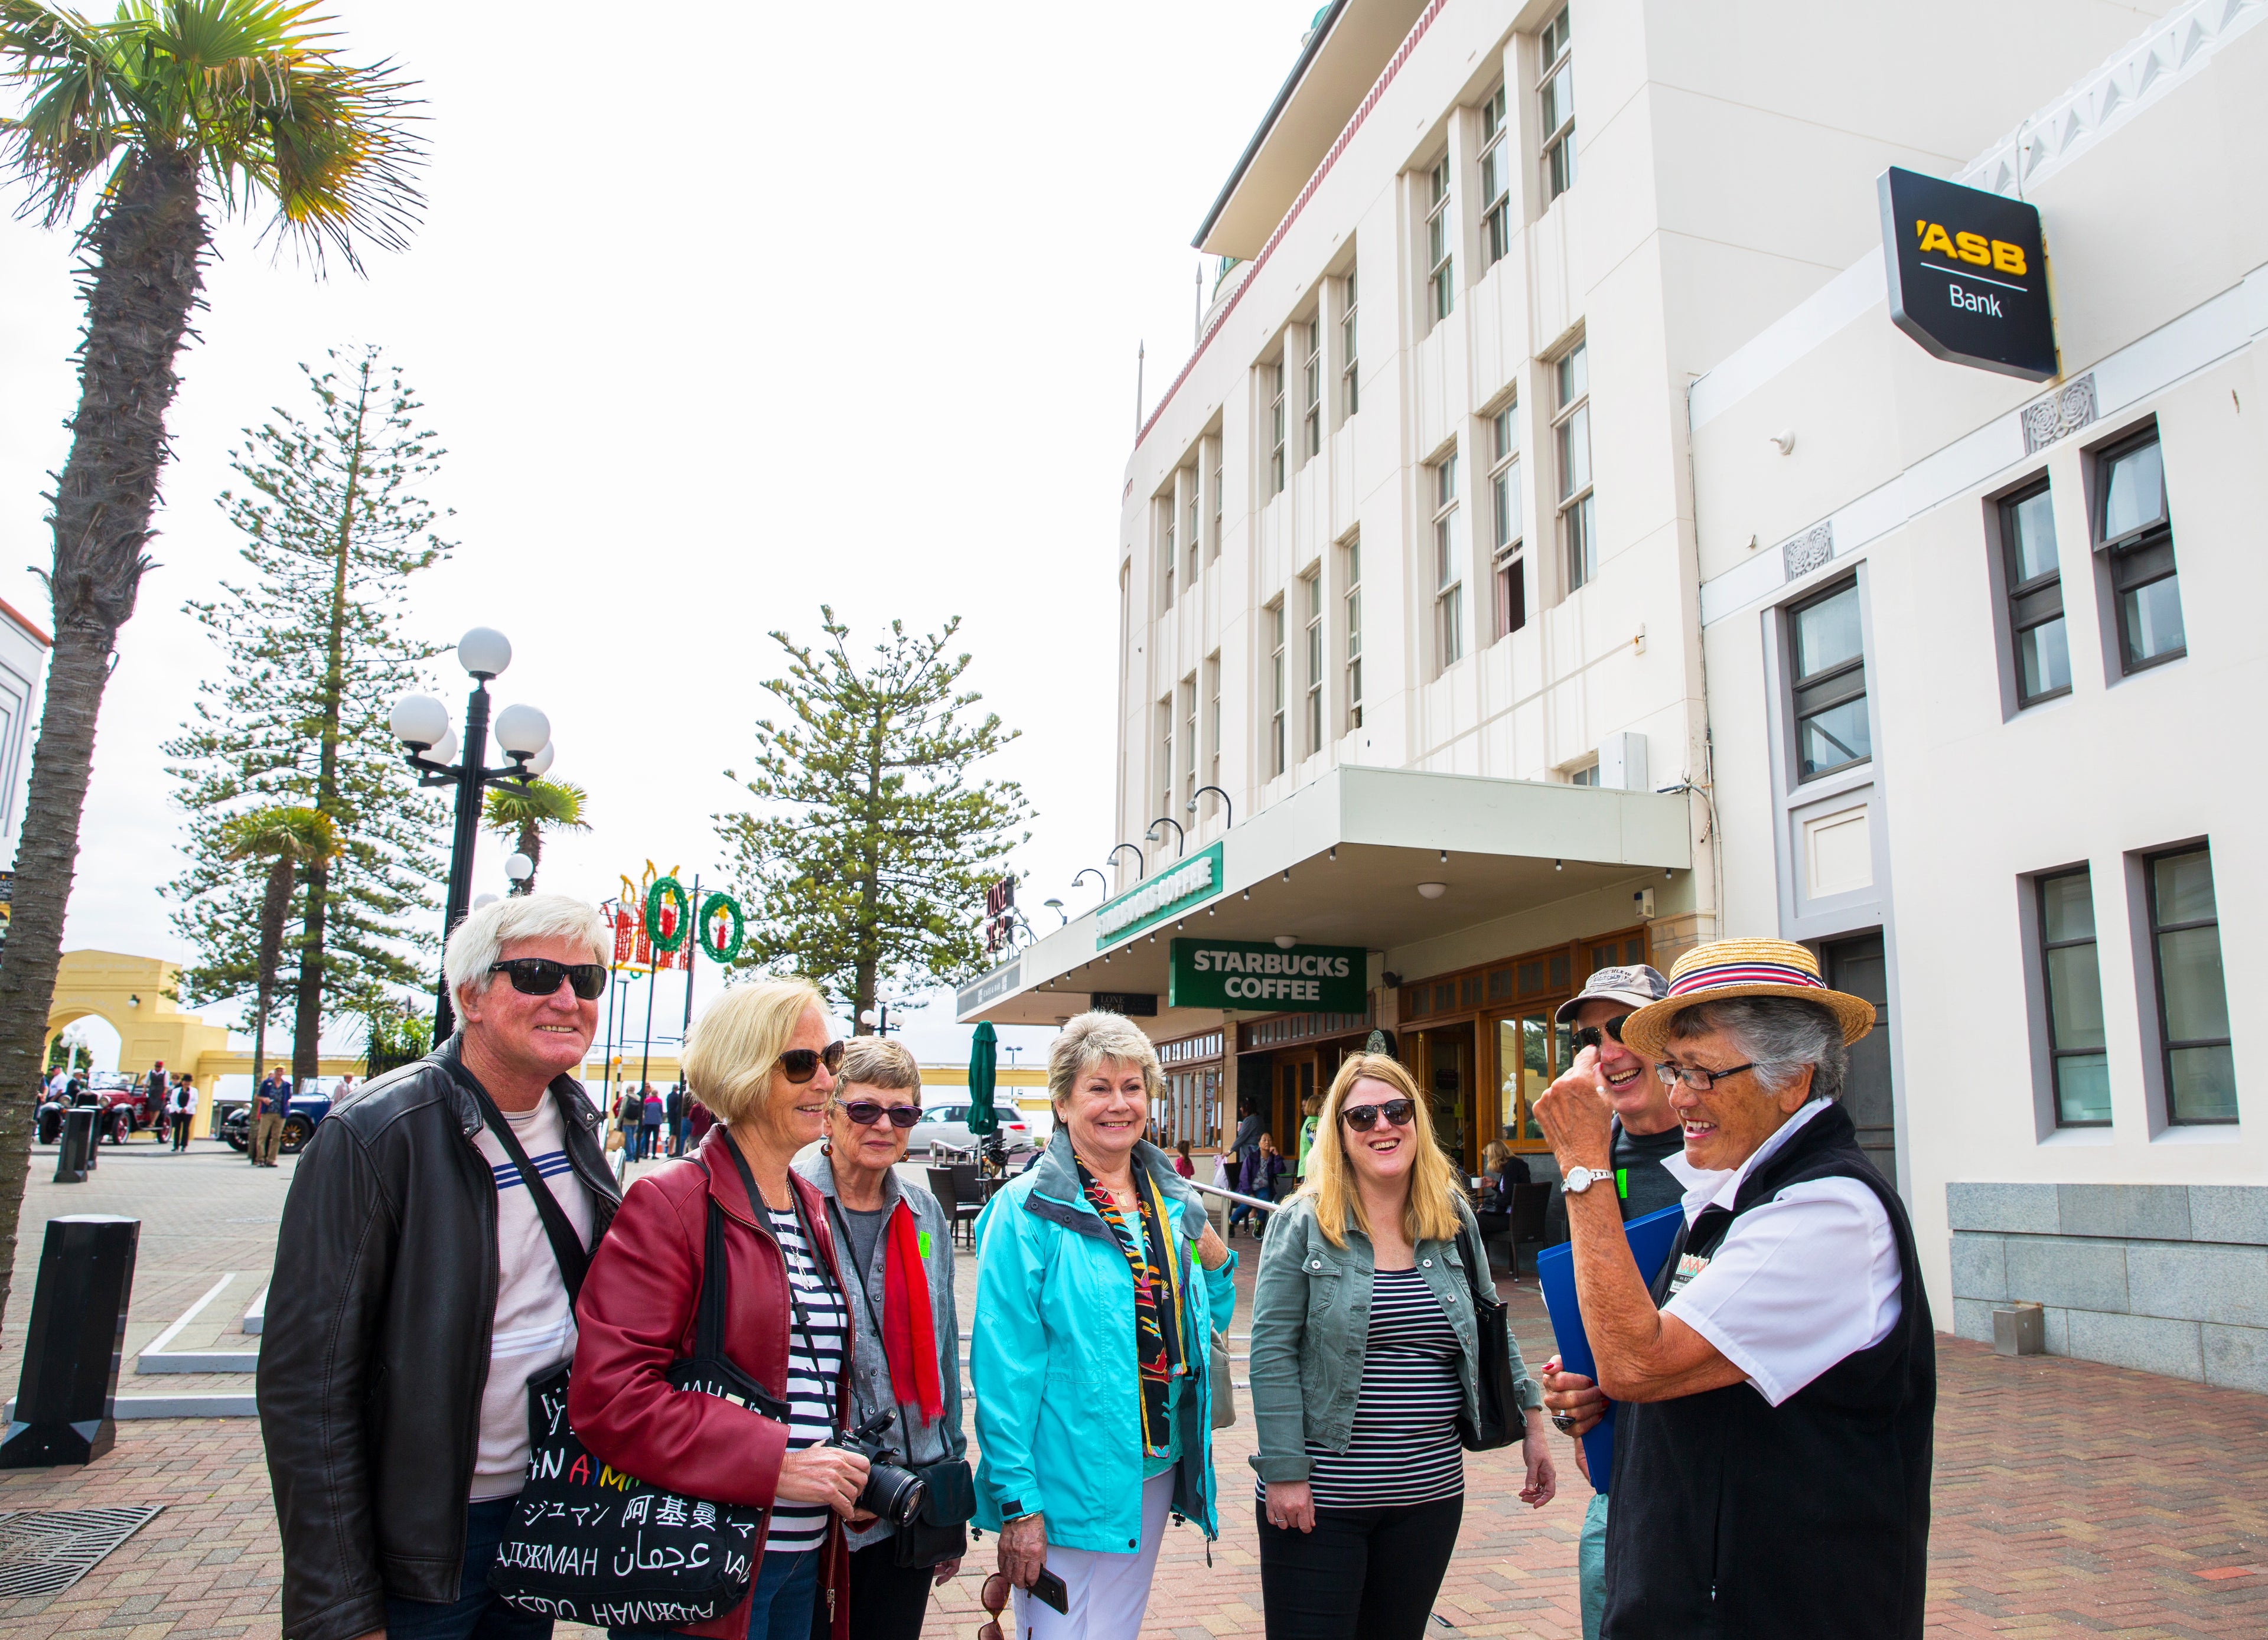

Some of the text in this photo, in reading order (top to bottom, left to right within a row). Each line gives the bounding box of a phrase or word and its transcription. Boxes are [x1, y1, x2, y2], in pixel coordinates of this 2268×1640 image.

[1949, 283, 2003, 318] Bank
[1194, 950, 1350, 977] STARBUCKS
[1100, 995, 1125, 1004] LONE
[1224, 977, 1320, 1001] COFFEE
[621, 1495, 716, 1531] 阿基曼
[614, 1530, 710, 1576] عجمان
